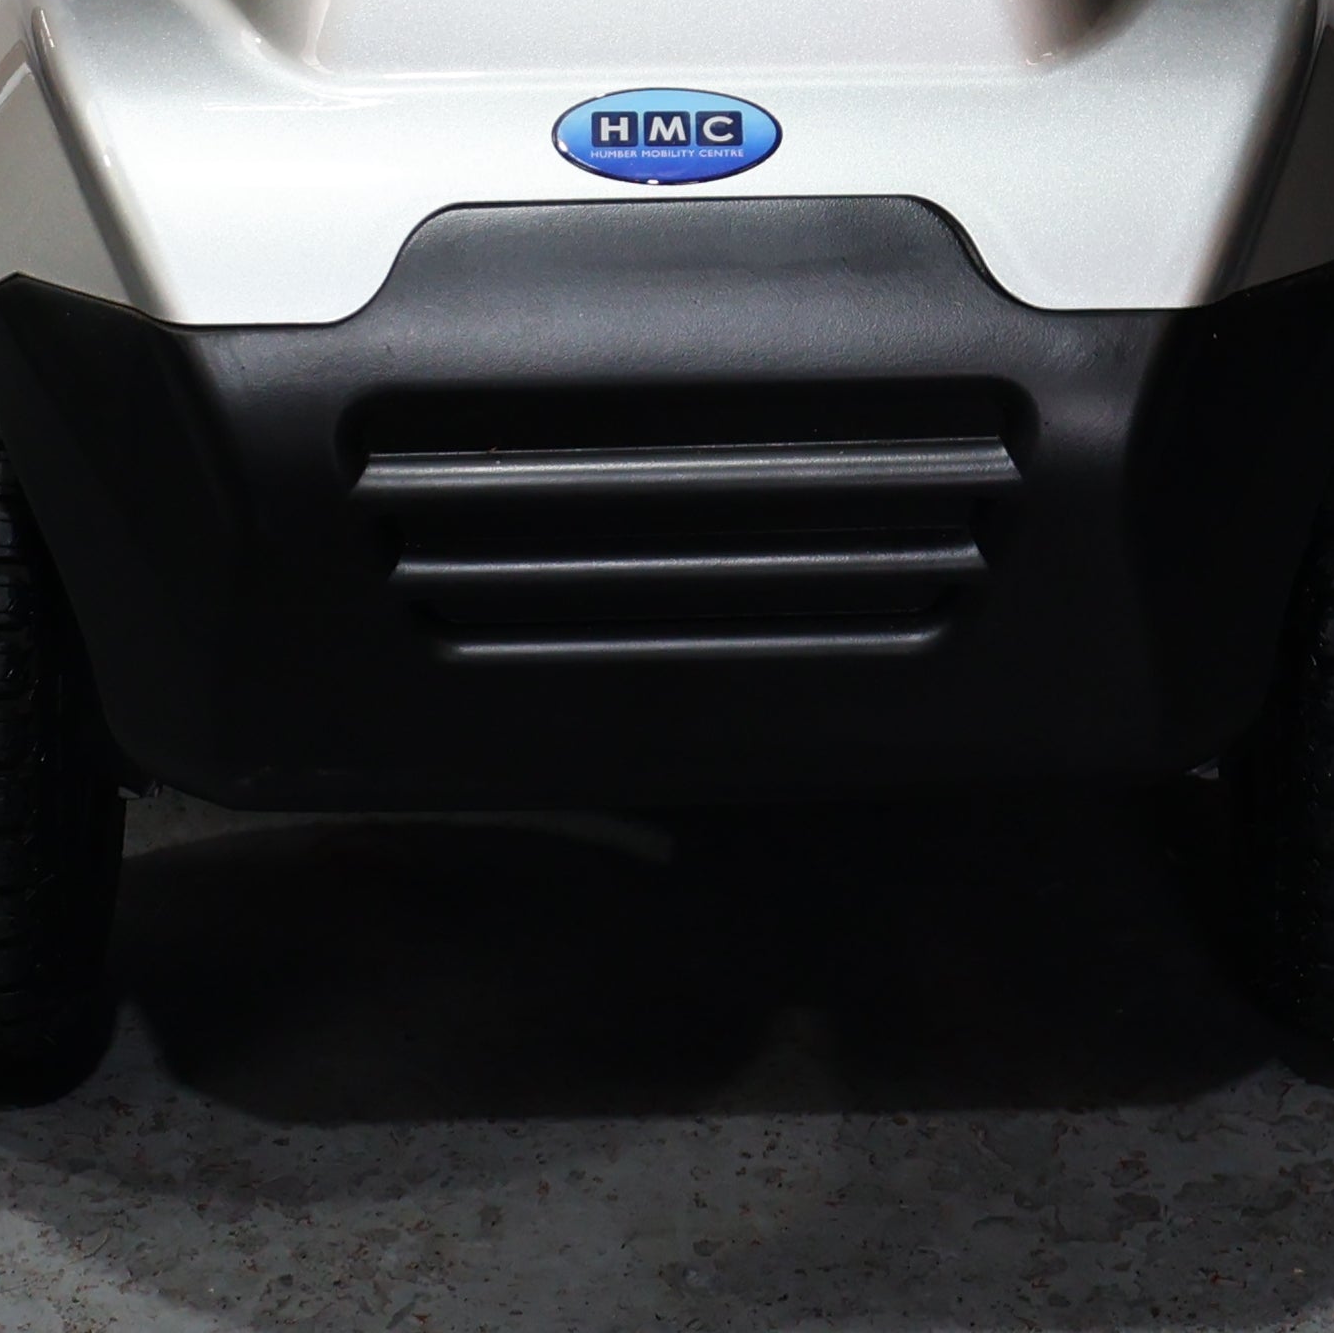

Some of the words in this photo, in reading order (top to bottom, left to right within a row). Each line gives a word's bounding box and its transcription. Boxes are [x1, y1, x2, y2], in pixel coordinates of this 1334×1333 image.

[600, 116, 734, 142] HMC
[590, 149, 637, 158] HUMBER
[641, 149, 695, 158] MOBILITY
[698, 148, 744, 158] CENTRE
